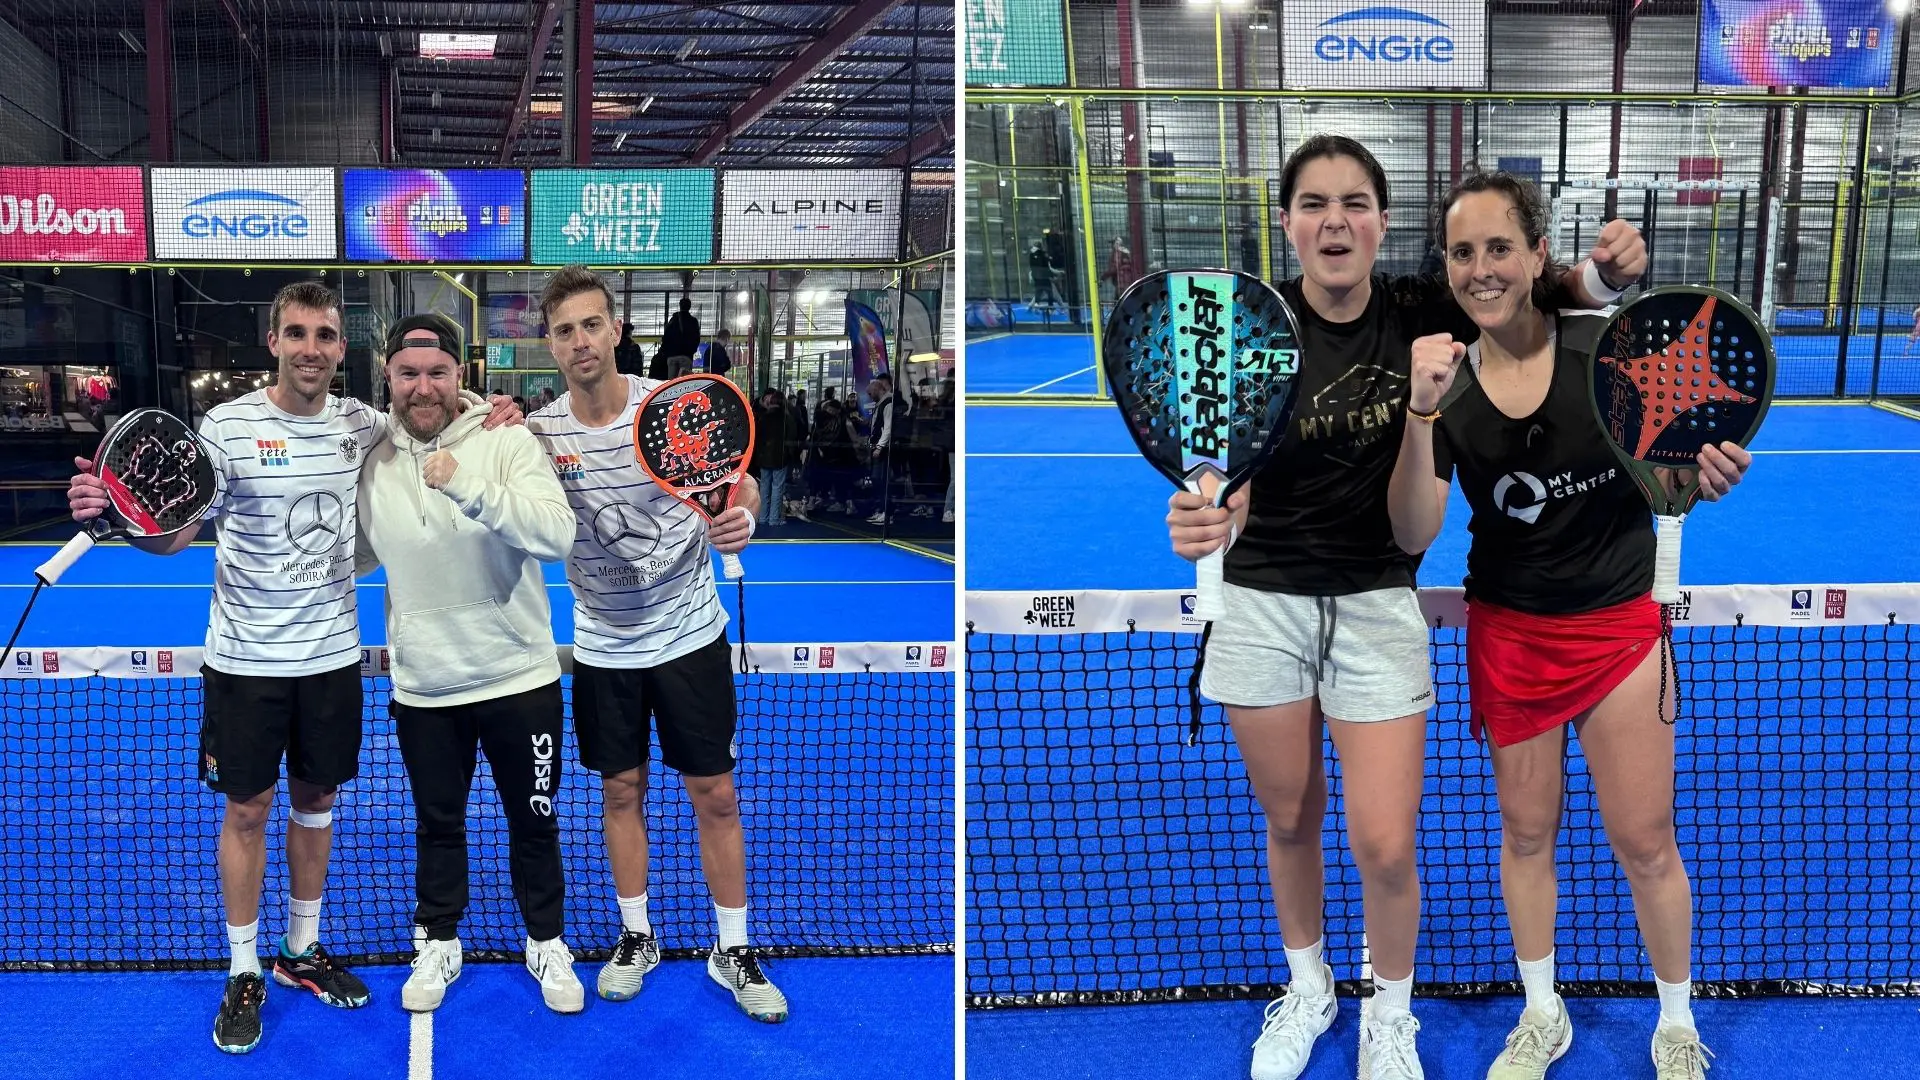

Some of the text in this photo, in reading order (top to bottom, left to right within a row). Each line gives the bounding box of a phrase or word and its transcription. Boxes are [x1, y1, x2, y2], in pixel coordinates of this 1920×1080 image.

[1769, 16, 1832, 44] PADEL
[582, 182, 663, 216] GREEN
[743, 200, 883, 215] ALPINE
[408, 196, 467, 220] PADEL
[592, 219, 662, 252] WEEZ
[1300, 414, 1334, 440] MY
[1651, 449, 1694, 458] TITANIA
[1548, 471, 1572, 489] MY
[1553, 468, 1616, 498] CENTER
[598, 557, 676, 577] Mercedes-Benz
[609, 575, 646, 587] SODIRA
[1033, 596, 1075, 612] GREEN
[1828, 593, 1844, 601] TEN
[1040, 612, 1075, 628] WEEZ
[1827, 607, 1842, 616] NIS
[44, 653, 57, 661] TEN
[1411, 690, 1431, 703] HEAD
[531, 733, 553, 791] asics
